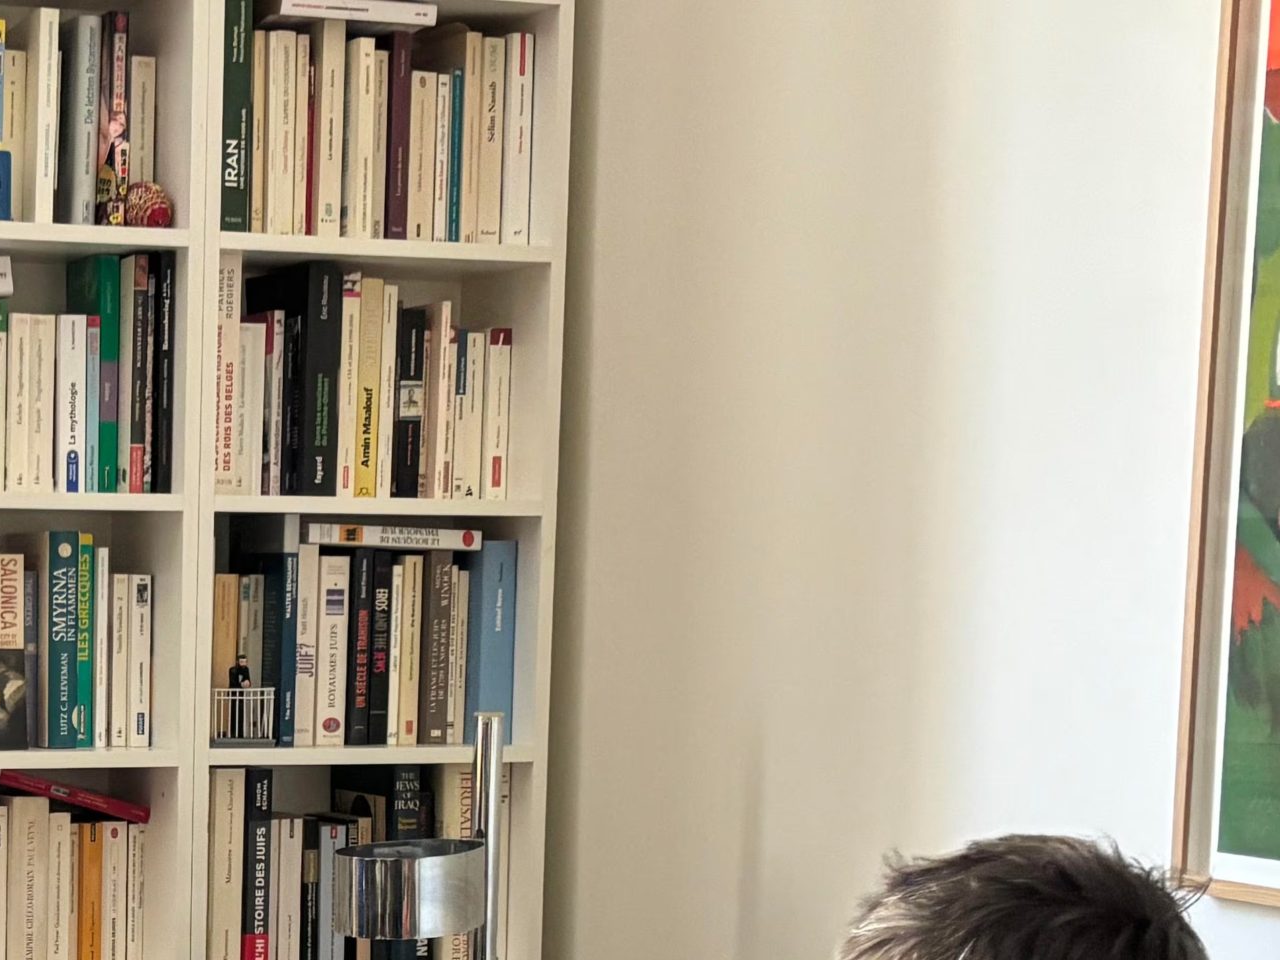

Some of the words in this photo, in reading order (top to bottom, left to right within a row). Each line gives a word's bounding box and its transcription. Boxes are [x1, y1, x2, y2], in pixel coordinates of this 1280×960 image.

[84, 76, 95, 107] letzten
[84, 109, 94, 125] Die
[486, 114, 497, 143] Sélim
[224, 139, 239, 188] IRAN
[226, 268, 235, 319] ROEGIERS
[225, 361, 234, 401] BELGES
[68, 382, 79, 433] mythologie
[224, 402, 233, 424] DES
[362, 387, 373, 435] Maalouf
[68, 434, 77, 446] La
[224, 425, 232, 450] ROIS
[272, 420, 282, 467] Amsterdam
[223, 451, 232, 472] DES
[360, 437, 371, 468] Amin
[314, 456, 324, 484] fayard
[393, 536, 429, 545] BOUQUIN
[0, 558, 18, 630] SALONICA
[67, 567, 76, 630] FLAMMEN
[78, 553, 90, 630] GRECQUES
[440, 563, 452, 607] WINOCK
[52, 567, 67, 642] SMYRNA
[285, 594, 293, 618] WALTER
[375, 589, 389, 611] EROS
[67, 631, 76, 641] IN
[327, 624, 339, 650] JUIFS
[357, 608, 369, 651] TRAHISON
[298, 643, 314, 678] JUIF?
[356, 653, 367, 664] DE
[374, 651, 386, 673] JEWS
[60, 652, 69, 702] KLEVEMAN
[326, 652, 337, 709] ROYAUMES
[353, 665, 367, 695] SIÈCLE
[60, 703, 69, 711] C.
[355, 696, 366, 708] UN
[60, 712, 69, 735] LUTZ
[394, 780, 420, 792] JEWS
[400, 772, 415, 780] THE
[394, 800, 420, 812] IRAQ
[401, 791, 412, 800] OF
[255, 827, 267, 862] JUIFS
[255, 862, 266, 887] DES
